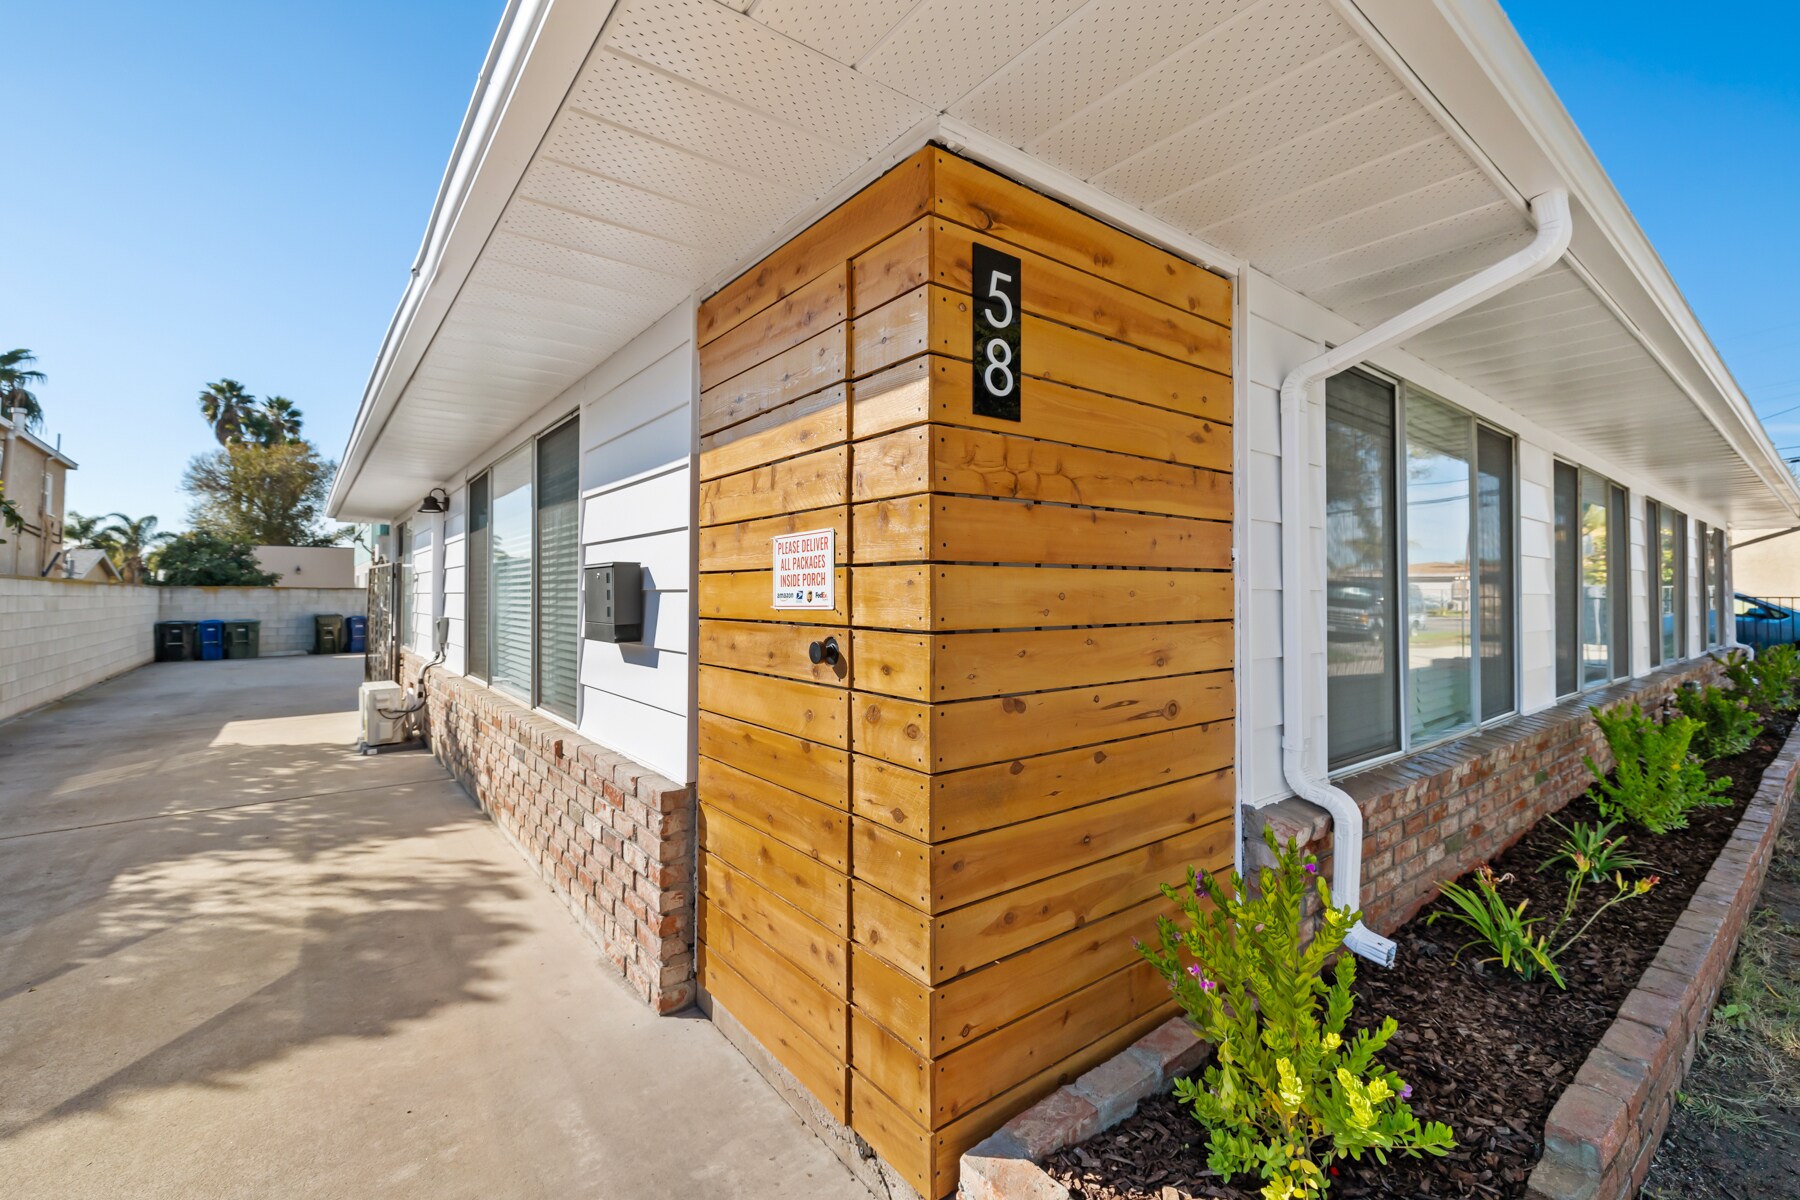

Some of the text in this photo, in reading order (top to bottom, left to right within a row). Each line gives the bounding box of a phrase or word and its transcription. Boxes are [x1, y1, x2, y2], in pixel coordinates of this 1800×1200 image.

[985, 270, 1014, 397] 58
[778, 536, 829, 555] PLEASE DELIVER
[781, 554, 826, 571] ALL PACKAGES
[780, 572, 826, 588] INSIDE PORCH
